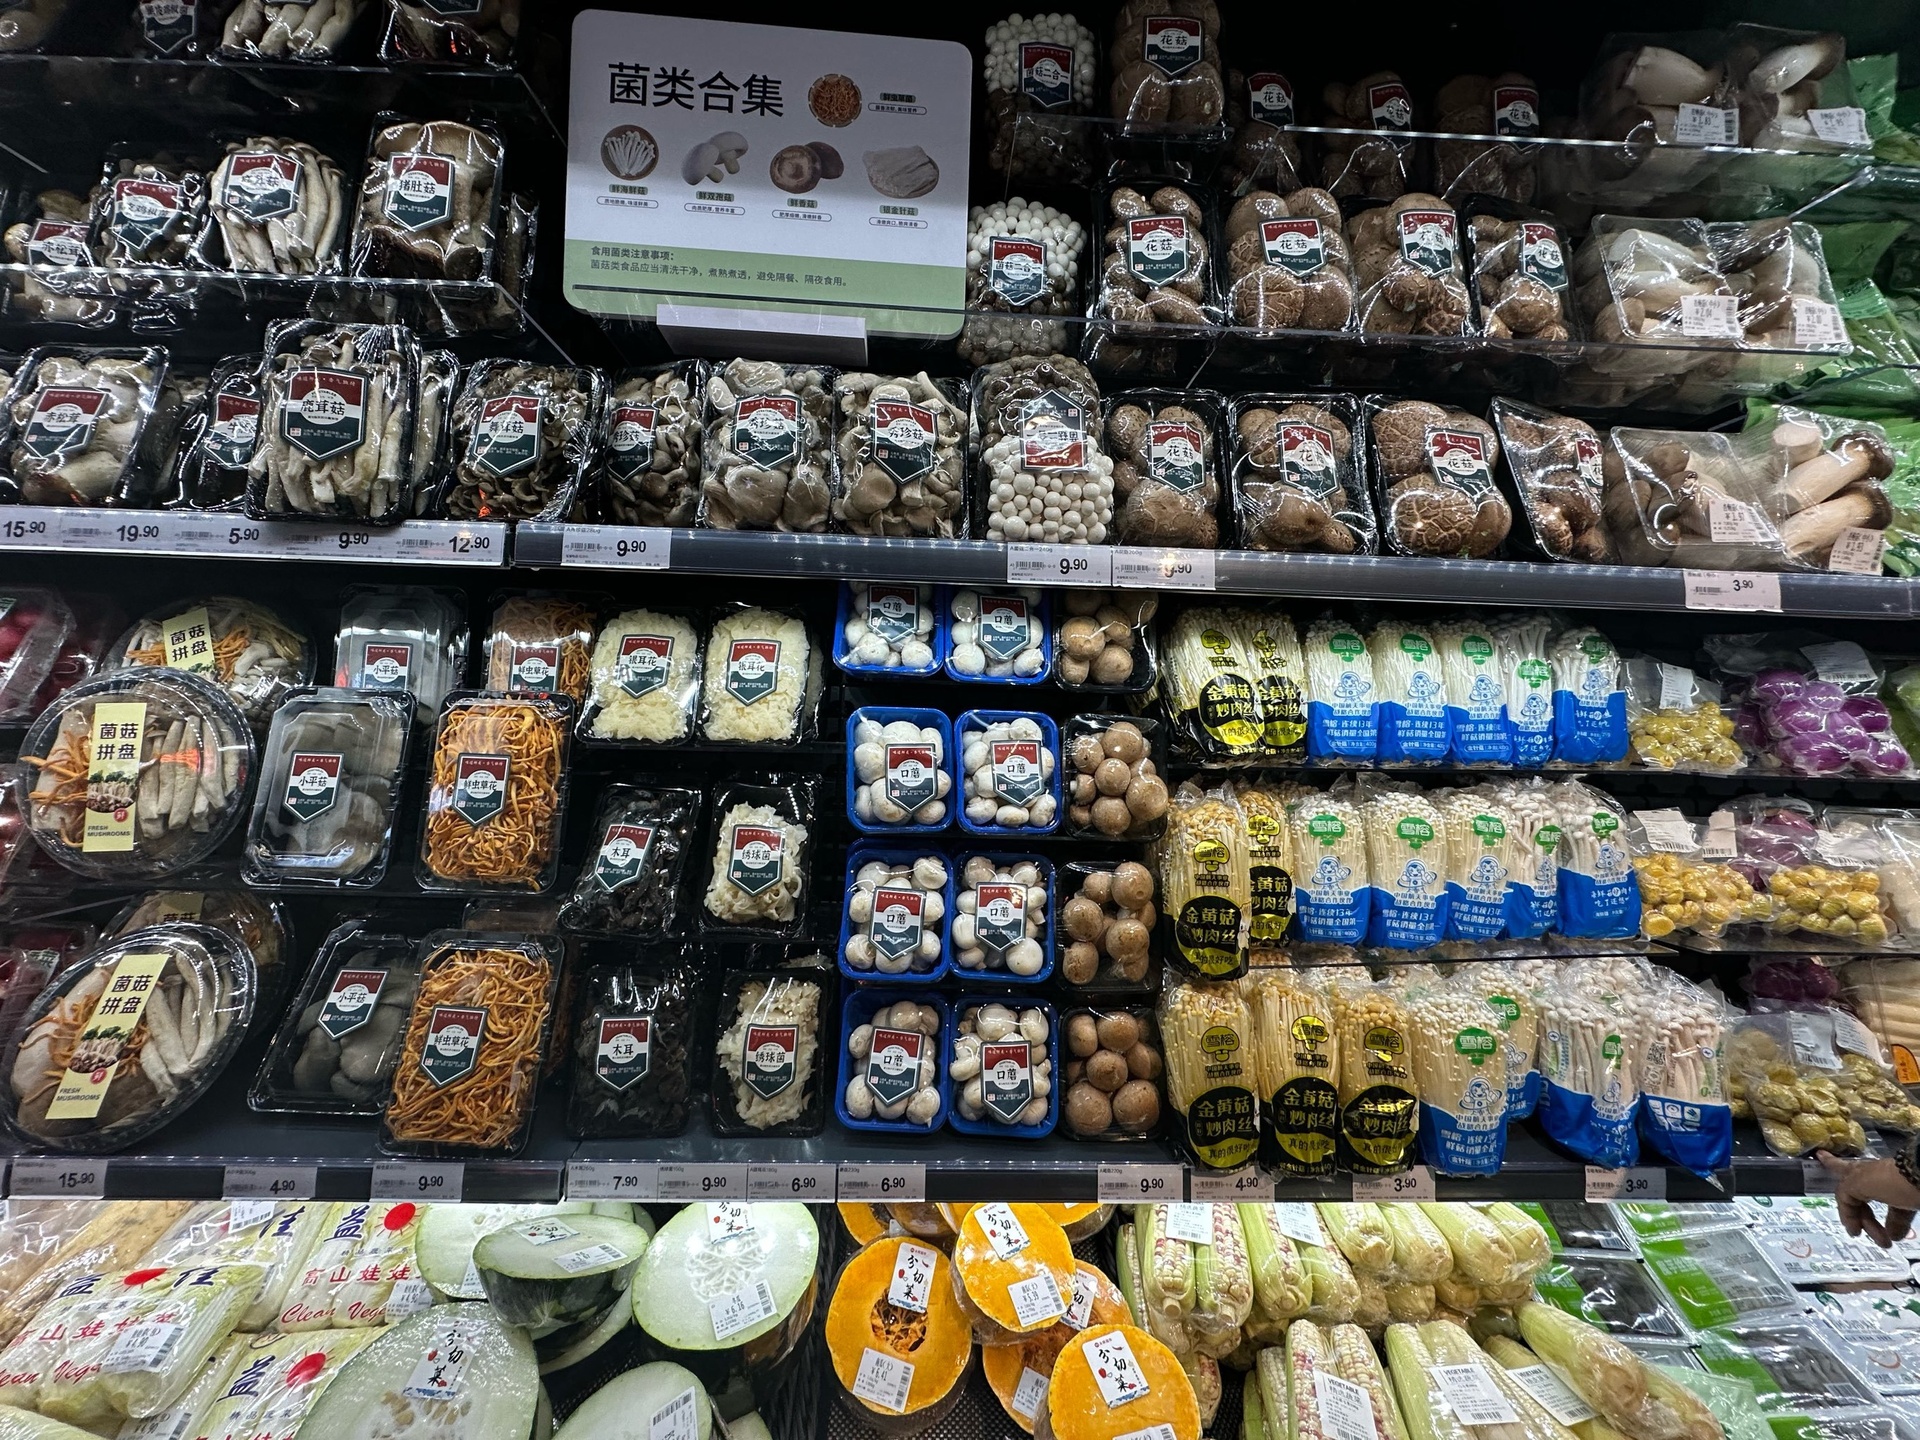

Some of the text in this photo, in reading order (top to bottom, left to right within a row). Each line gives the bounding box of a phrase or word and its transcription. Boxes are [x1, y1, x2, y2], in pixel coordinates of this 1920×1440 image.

[1160, 35, 1188, 46] 花菇
[608, 62, 784, 118] 菌类合集
[1262, 90, 1288, 104] 花菇
[1508, 107, 1532, 120] 花菇
[398, 178, 437, 195] 猪肚菇
[698, 191, 733, 202] 鲜双孢菇
[1144, 238, 1173, 252] 花菇
[1278, 239, 1308, 250] 花菇
[590, 245, 675, 261] 食用菌类注意事项：
[590, 259, 848, 287] 菌菇类食品应当清洗干净，煮熟煮透，避免隔餐、隔夜食用。
[301, 399, 346, 415] 鹿茸菇
[888, 426, 924, 440] 秀珍菇
[1448, 459, 1474, 469] 花菇
[3, 521, 46, 538] 15.90
[117, 525, 159, 542] 19.90
[228, 528, 260, 545] 5.90
[338, 532, 369, 550] 9.90
[449, 536, 490, 553] 12.90
[616, 540, 647, 557] 9.90
[1060, 558, 1088, 575] 9.90
[1164, 562, 1192, 578] 9.90
[1733, 580, 1754, 592] 3.90
[994, 615, 1013, 626] 口蘑
[170, 624, 206, 646] 菌菇
[172, 641, 208, 661] 拼盘
[1402, 639, 1429, 650] 雪榕
[1464, 642, 1490, 653] 雪榕
[373, 665, 399, 676] 小平菇
[518, 666, 550, 677] 鲜虫草花
[1207, 684, 1251, 701] 金黄菇
[100, 723, 139, 739] 菌菇
[97, 744, 136, 761] 拼盘
[901, 768, 920, 779] 口蘑
[1007, 763, 1026, 774] 口蘑
[299, 775, 328, 788] 小平菇
[463, 780, 498, 791] 鲜虫草花
[1312, 821, 1342, 833] 雪榕
[1400, 823, 1431, 836] 雪榕
[1475, 821, 1503, 834] 雪榕
[611, 848, 632, 859] 木耳
[886, 913, 906, 925] 口蘑
[990, 906, 1010, 918] 口蘑
[1186, 908, 1236, 925] 金黄菇
[111, 975, 153, 992] 菌菇
[338, 991, 367, 1004] 小平菇
[100, 997, 141, 1016] 拼盘
[434, 1034, 470, 1049] 鲜虫草花
[1206, 1035, 1235, 1047] 雪榕
[1370, 1034, 1400, 1047] 雪榕
[1460, 1035, 1492, 1049] 雪榕
[612, 1043, 634, 1056] 木耳
[755, 1050, 786, 1064] 绣球菌
[883, 1054, 903, 1067] 口蘑
[997, 1069, 1018, 1081] 口蘑
[56, 1094, 100, 1102] MUSHROOMS
[1284, 1087, 1334, 1108] 金黄菇
[1198, 1096, 1250, 1118] 金黄菇
[1289, 1111, 1334, 1129] 炒肉丝
[1206, 1119, 1252, 1137] 炒肉丝
[59, 1173, 95, 1188] 15.90
[270, 1180, 295, 1195] 4.90
[418, 1175, 444, 1191] 9.90
[613, 1176, 638, 1191] 7.90
[702, 1176, 727, 1192] 9.90
[791, 1177, 816, 1192] 6.90
[881, 1177, 906, 1192] 6.90
[1141, 1178, 1164, 1193] 9.90
[1235, 1177, 1259, 1191] 4.90
[1394, 1178, 1417, 1192] 3.90
[1626, 1179, 1648, 1193] 3.90
[259, 1206, 306, 1238] 佳
[324, 1204, 370, 1243] 益
[987, 1213, 1014, 1248] 分切菜
[57, 1265, 223, 1300] 益 佳
[302, 1263, 422, 1287] 高山娃娃
[906, 1253, 924, 1301] 分切菜
[1066, 1280, 1084, 1317] 切菜
[281, 1302, 336, 1324] Clean
[725, 1302, 746, 1316] ¥6.16
[428, 1329, 465, 1388] 分切菜
[217, 1354, 278, 1402] 益
[1098, 1349, 1130, 1393] 分切菜
[1443, 1367, 1475, 1376] VEGETABLE
[1516, 1368, 1542, 1378] VEGETABLE
[1327, 1377, 1361, 1396] VEGETABLE
